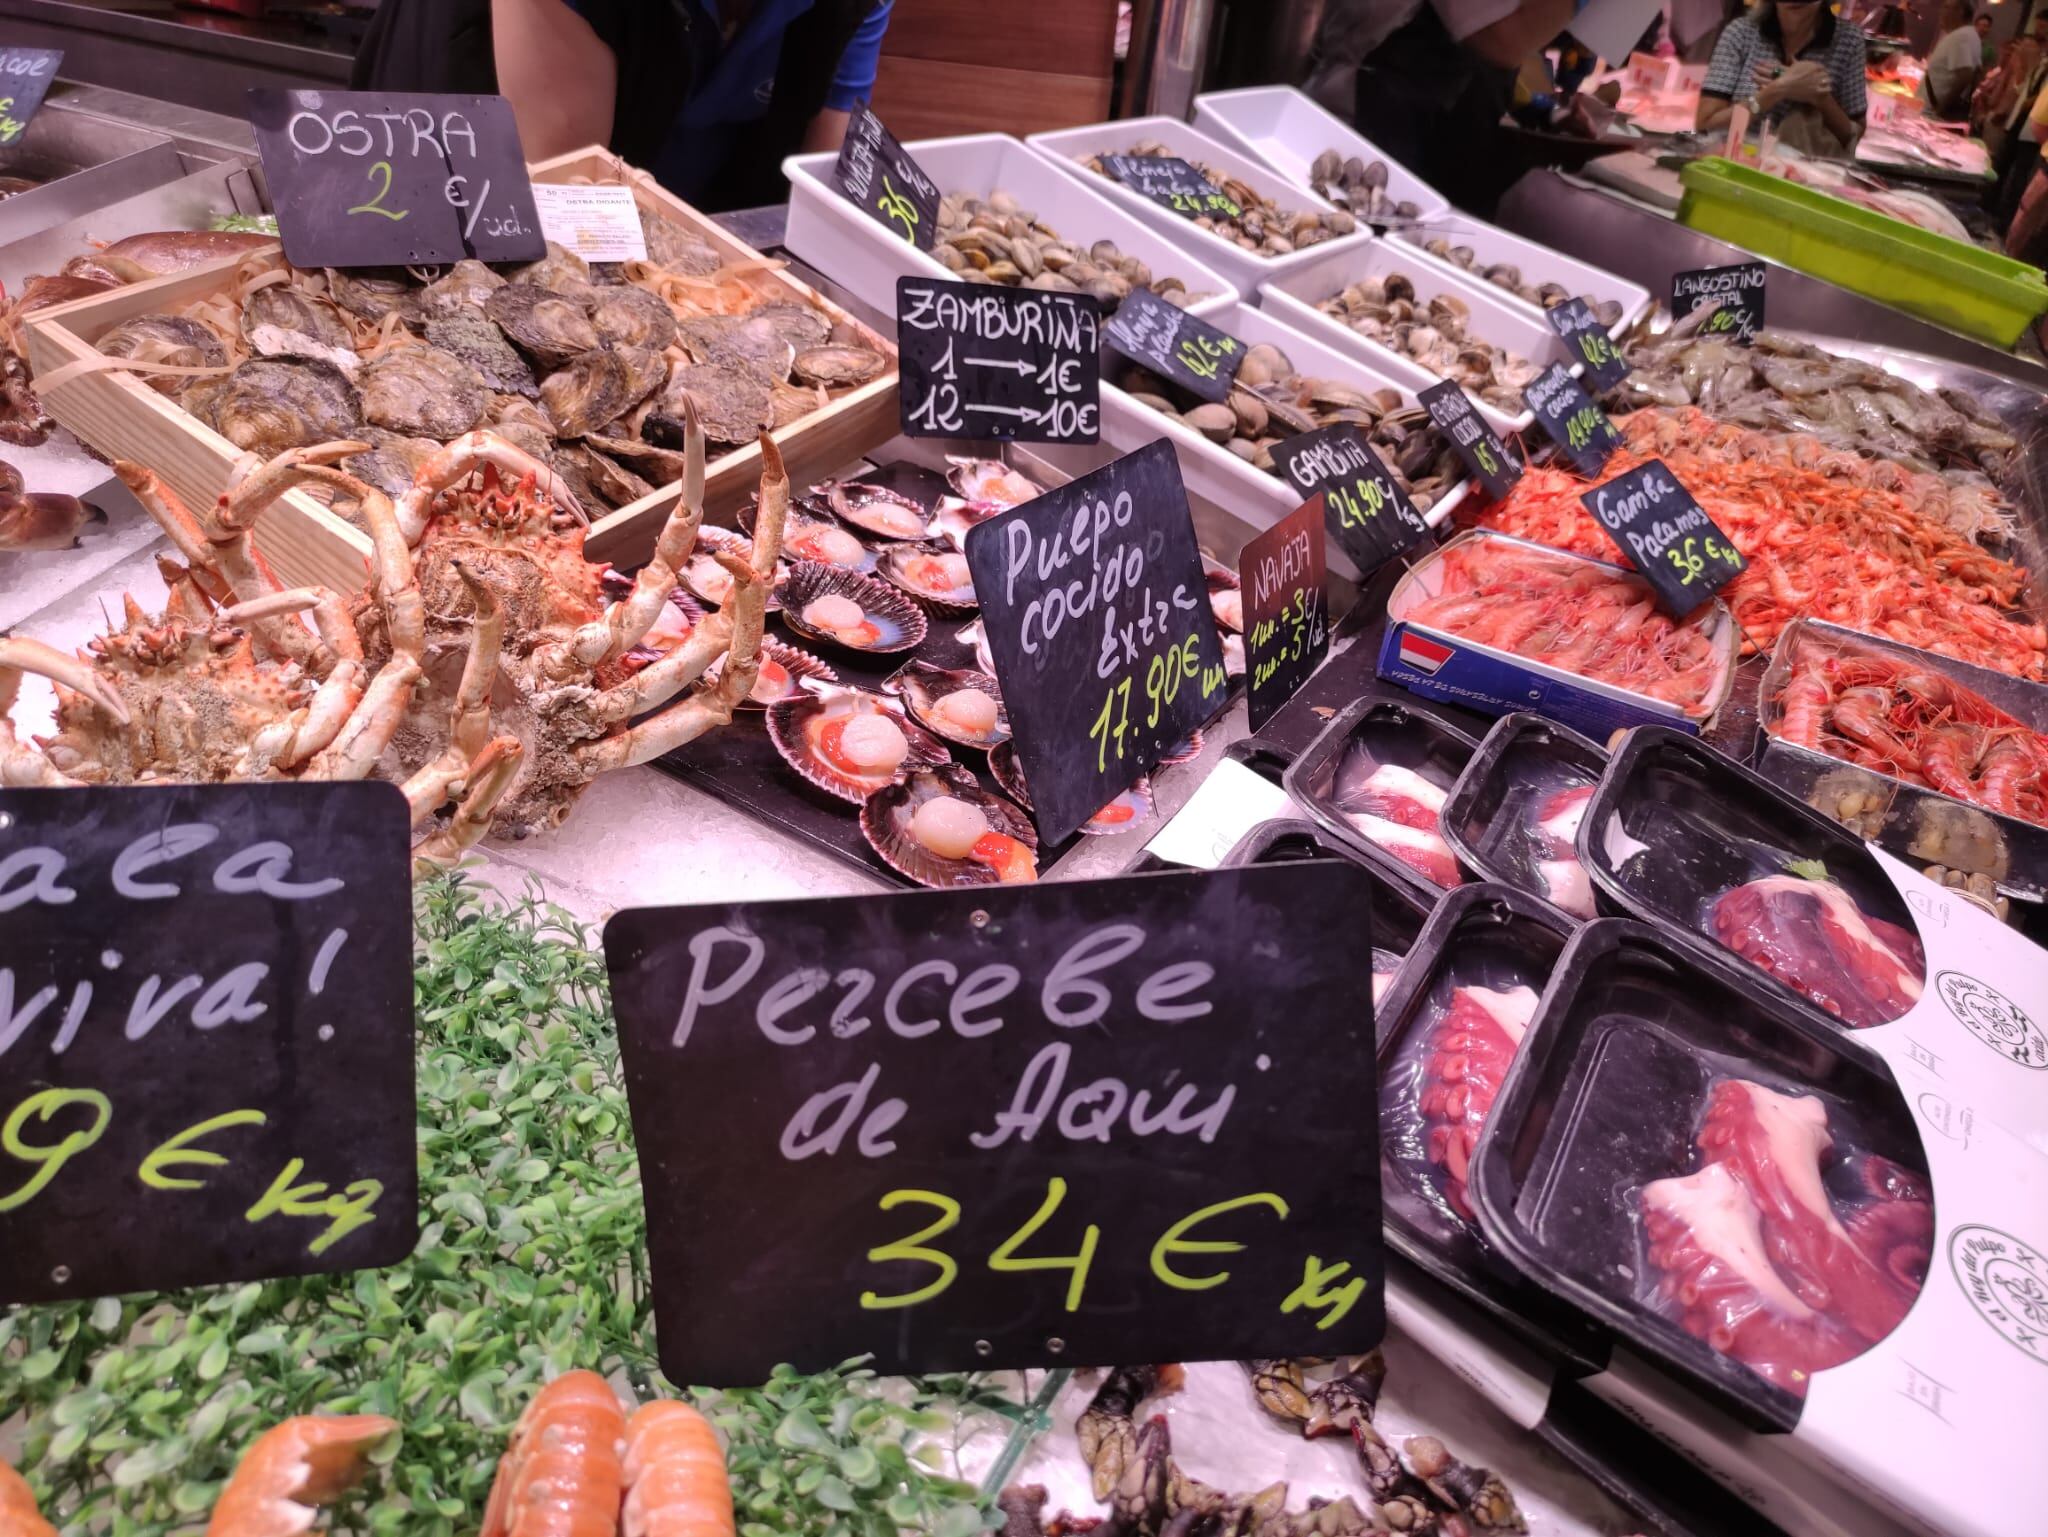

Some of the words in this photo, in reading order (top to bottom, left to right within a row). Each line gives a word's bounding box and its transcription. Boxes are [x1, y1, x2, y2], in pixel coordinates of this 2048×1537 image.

[289, 111, 476, 157] OSTRA
[347, 162, 409, 220] 2
[930, 335, 958, 380] 1
[1036, 351, 1082, 395] 1€
[908, 383, 963, 431] 12
[1036, 398, 1098, 437] 10€
[1007, 490, 1134, 606] Pulpo
[1254, 530, 1310, 611] NAVAJA
[1020, 543, 1144, 655] cocido
[673, 923, 1215, 1048] Percebe
[780, 1063, 908, 1161] de
